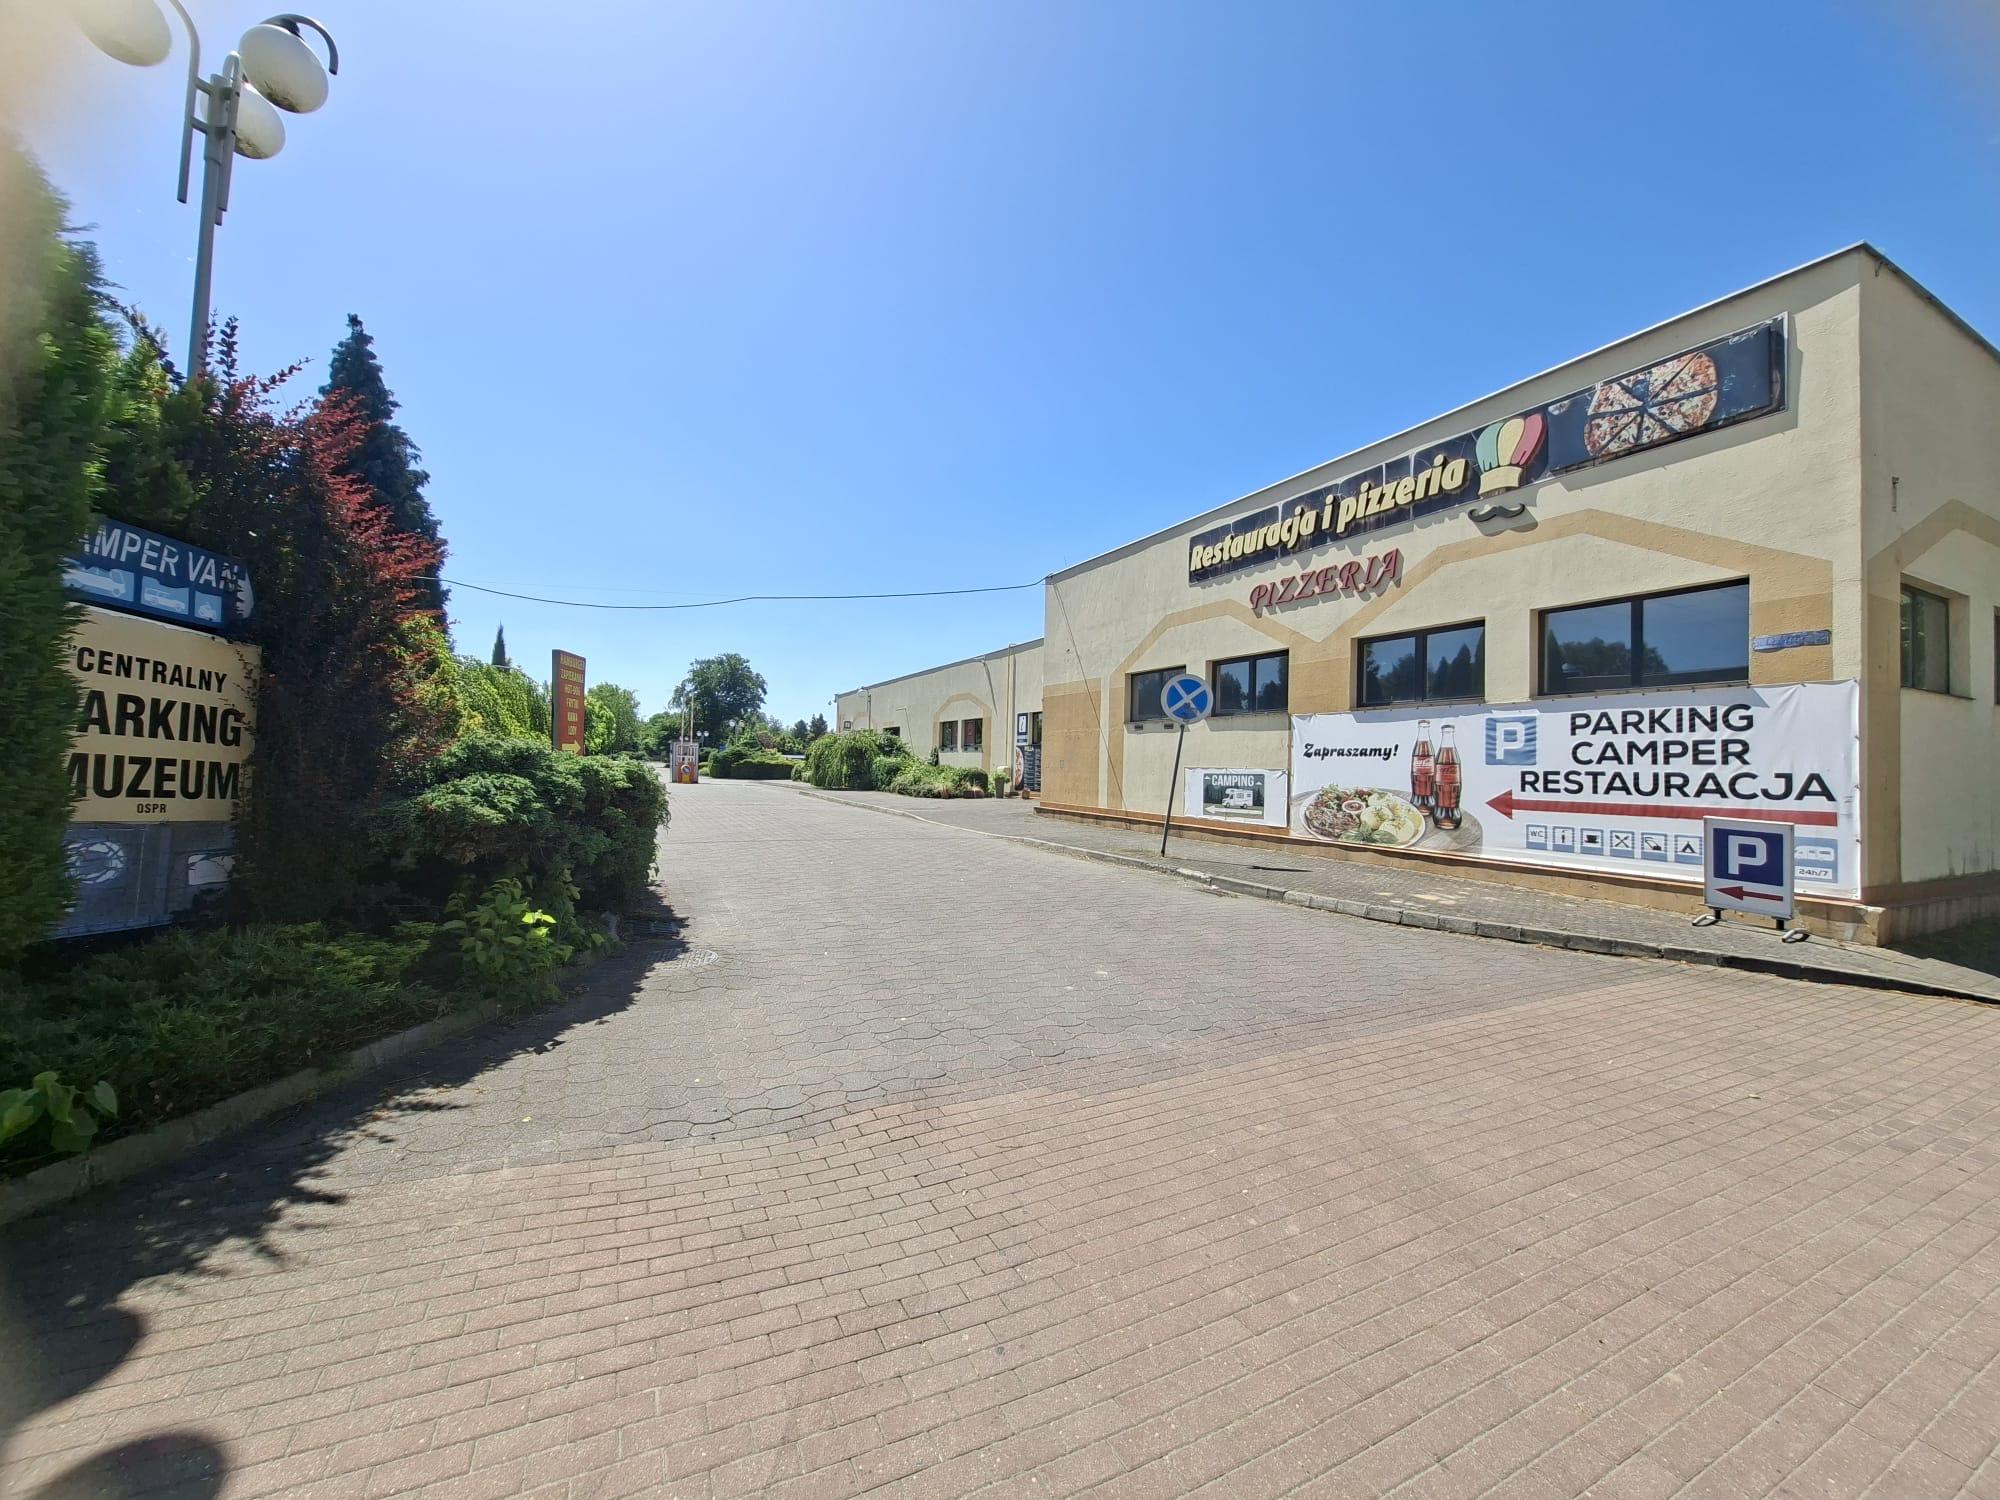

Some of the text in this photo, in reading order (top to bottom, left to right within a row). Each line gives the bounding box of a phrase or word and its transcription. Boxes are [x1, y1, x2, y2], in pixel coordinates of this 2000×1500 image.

[1190, 454, 1468, 572] Restauracja i pizzeria
[79, 527, 179, 577] MPER
[1250, 548, 1400, 610] PIZZERIA
[76, 689, 242, 747] ARKING
[1570, 703, 1754, 736] PARKING
[1303, 743, 1399, 761] Zapraszamy!
[1496, 721, 1525, 760] P
[1571, 738, 1751, 766] CAMPER
[1211, 774, 1255, 787] CAMPING
[1520, 770, 1838, 802] RESTAURACJA
[136, 803, 167, 814] OSPR
[1530, 830, 1544, 838] WC
[1727, 834, 1767, 875] P
[1798, 868, 1828, 877] 24h/7
